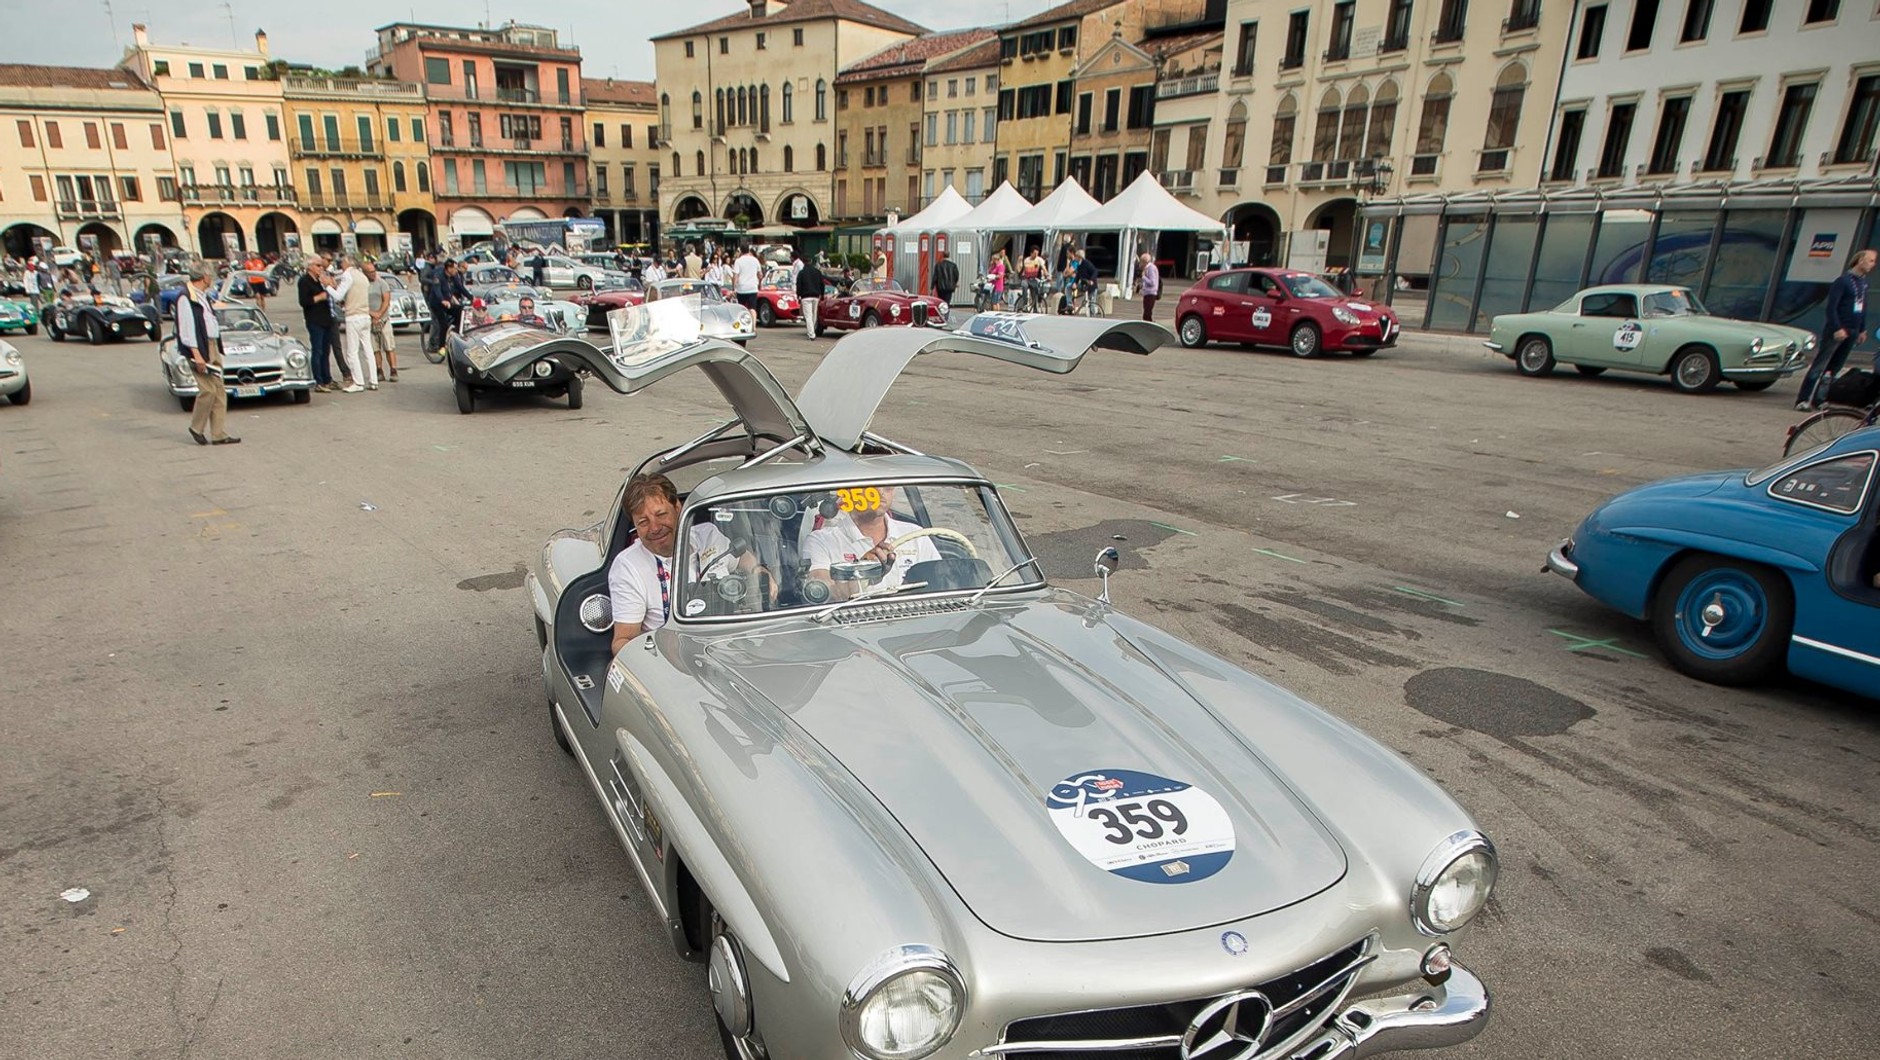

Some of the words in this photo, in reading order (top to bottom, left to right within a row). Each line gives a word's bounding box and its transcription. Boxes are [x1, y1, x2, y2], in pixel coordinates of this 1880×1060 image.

[1620, 332, 1635, 343] 415
[836, 486, 882, 513] 359
[1088, 799, 1188, 845] 359
[1136, 838, 1187, 851] CHOPARD
